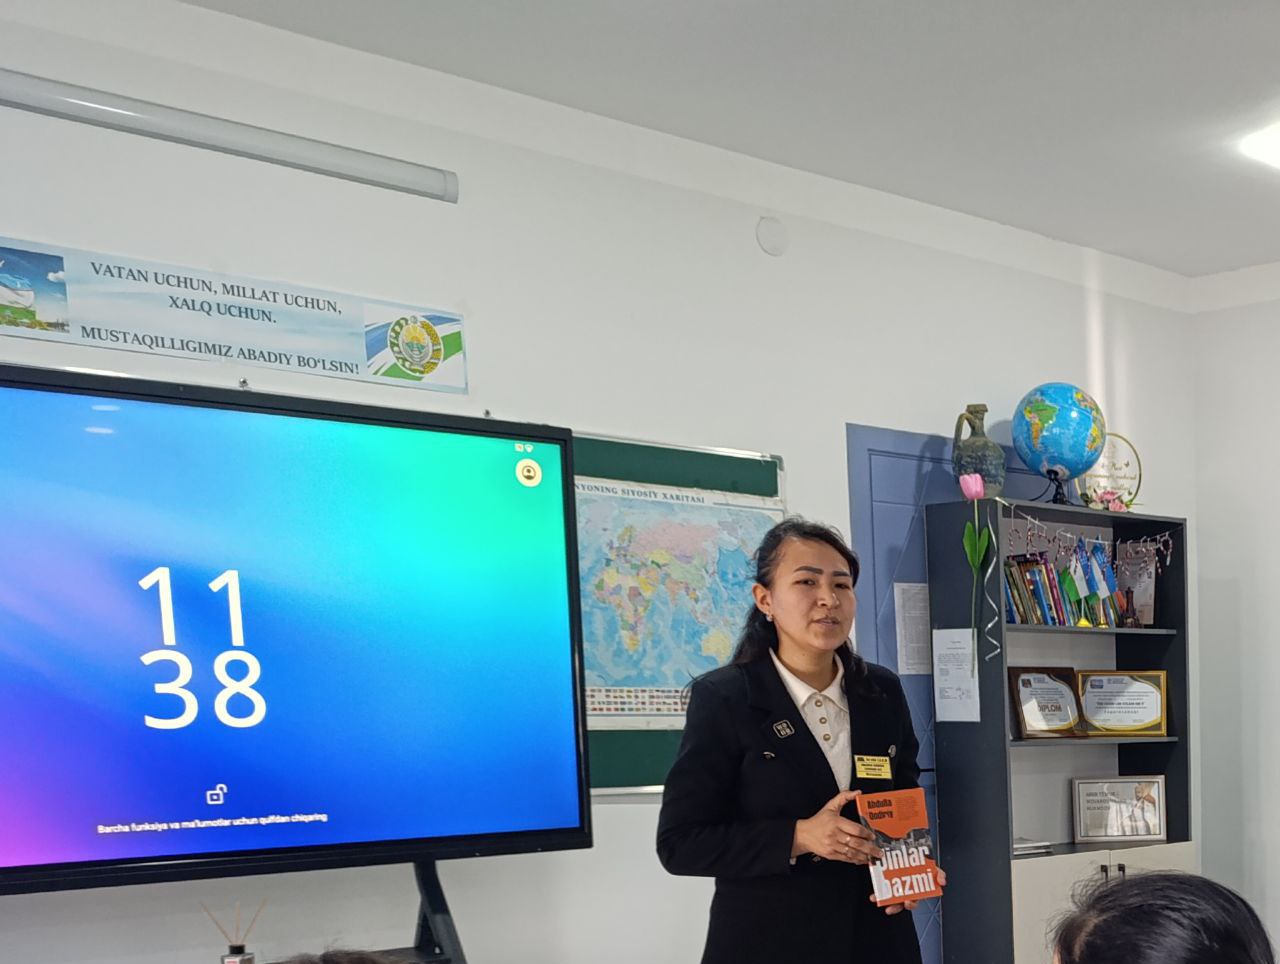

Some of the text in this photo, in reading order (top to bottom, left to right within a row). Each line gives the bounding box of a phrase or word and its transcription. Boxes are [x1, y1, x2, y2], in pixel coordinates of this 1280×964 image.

[90, 261, 342, 315] VATAN UCHUN, MILLAT UCHUN,
[168, 296, 277, 324] XALQ UCHUN.
[81, 325, 234, 358] MUSTAQILLIGIMIZ
[237, 345, 293, 367] ABADIY
[138, 566, 245, 646] 11
[140, 649, 267, 730] 38
[97, 824, 130, 833] Barcha
[232, 817, 258, 825] uchun
